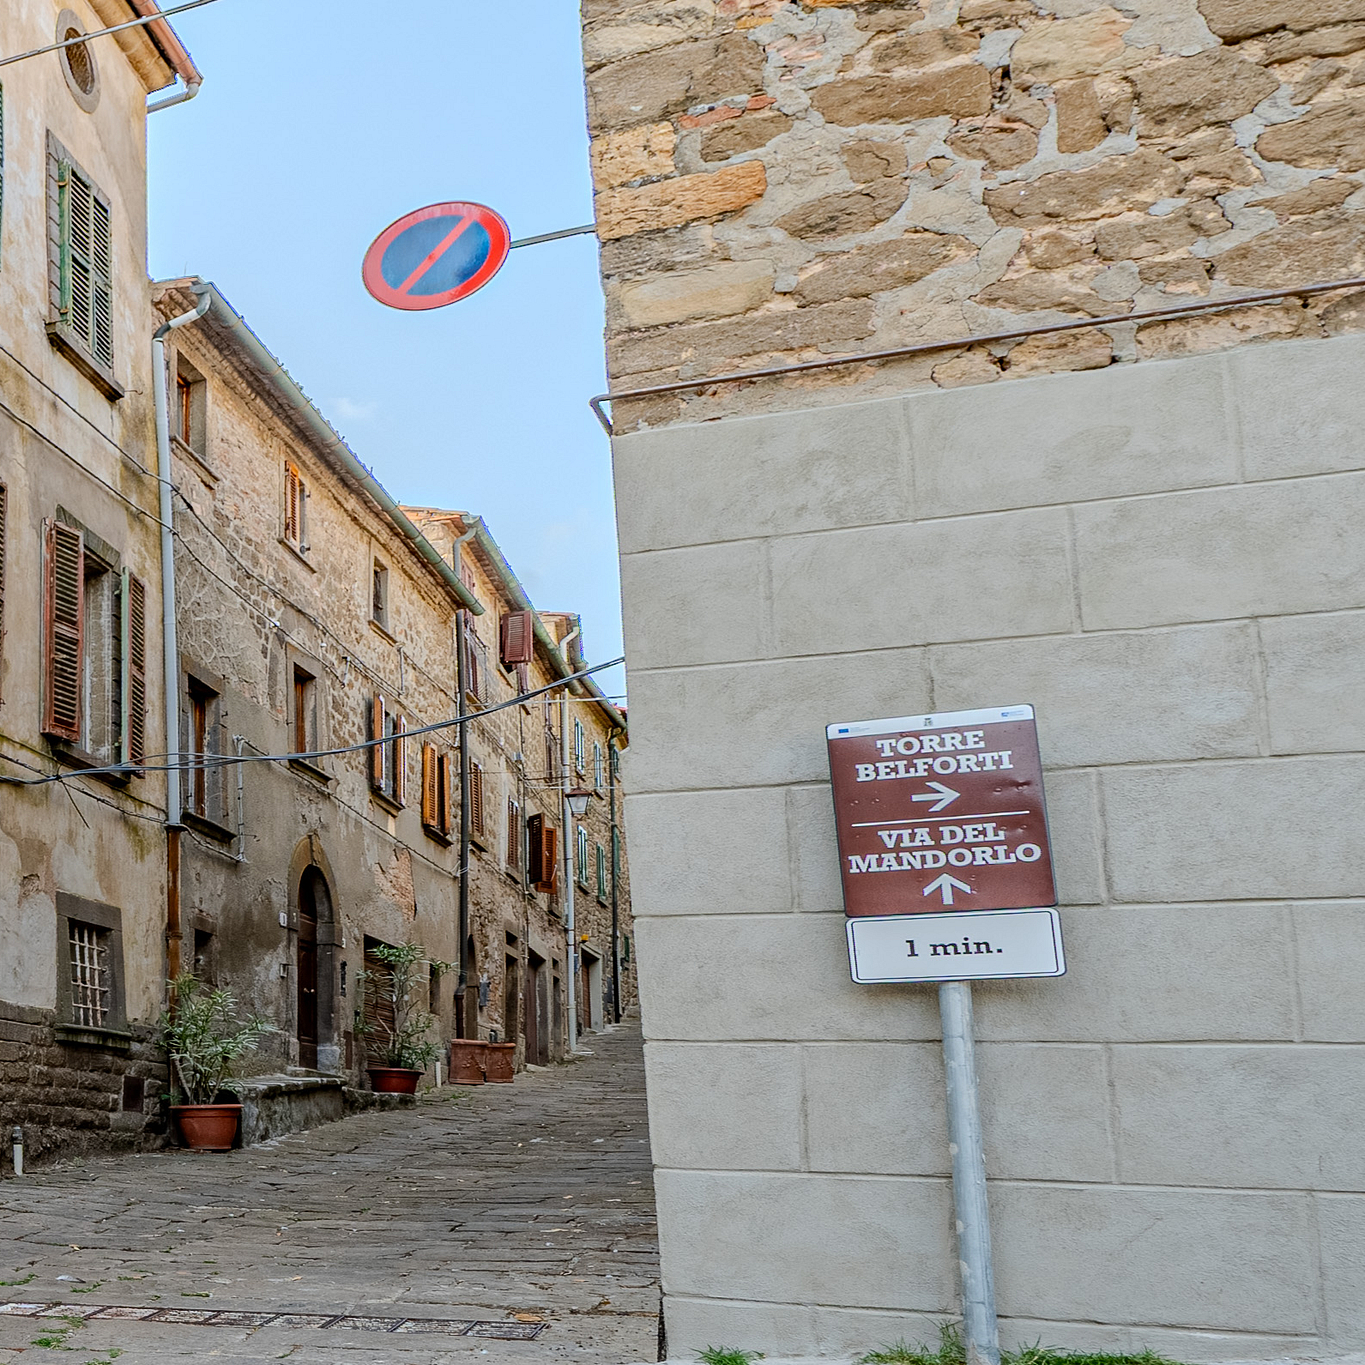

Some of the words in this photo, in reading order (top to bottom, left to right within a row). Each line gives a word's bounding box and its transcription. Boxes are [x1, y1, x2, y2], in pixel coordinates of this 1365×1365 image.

[876, 730, 985, 758] TORRE
[855, 750, 1014, 782] BELFORTI
[877, 827, 935, 849] VIA
[939, 822, 1006, 846] DEL
[848, 843, 1042, 874] MANDORLO
[905, 939, 919, 958] 1
[929, 936, 1004, 957] min.
